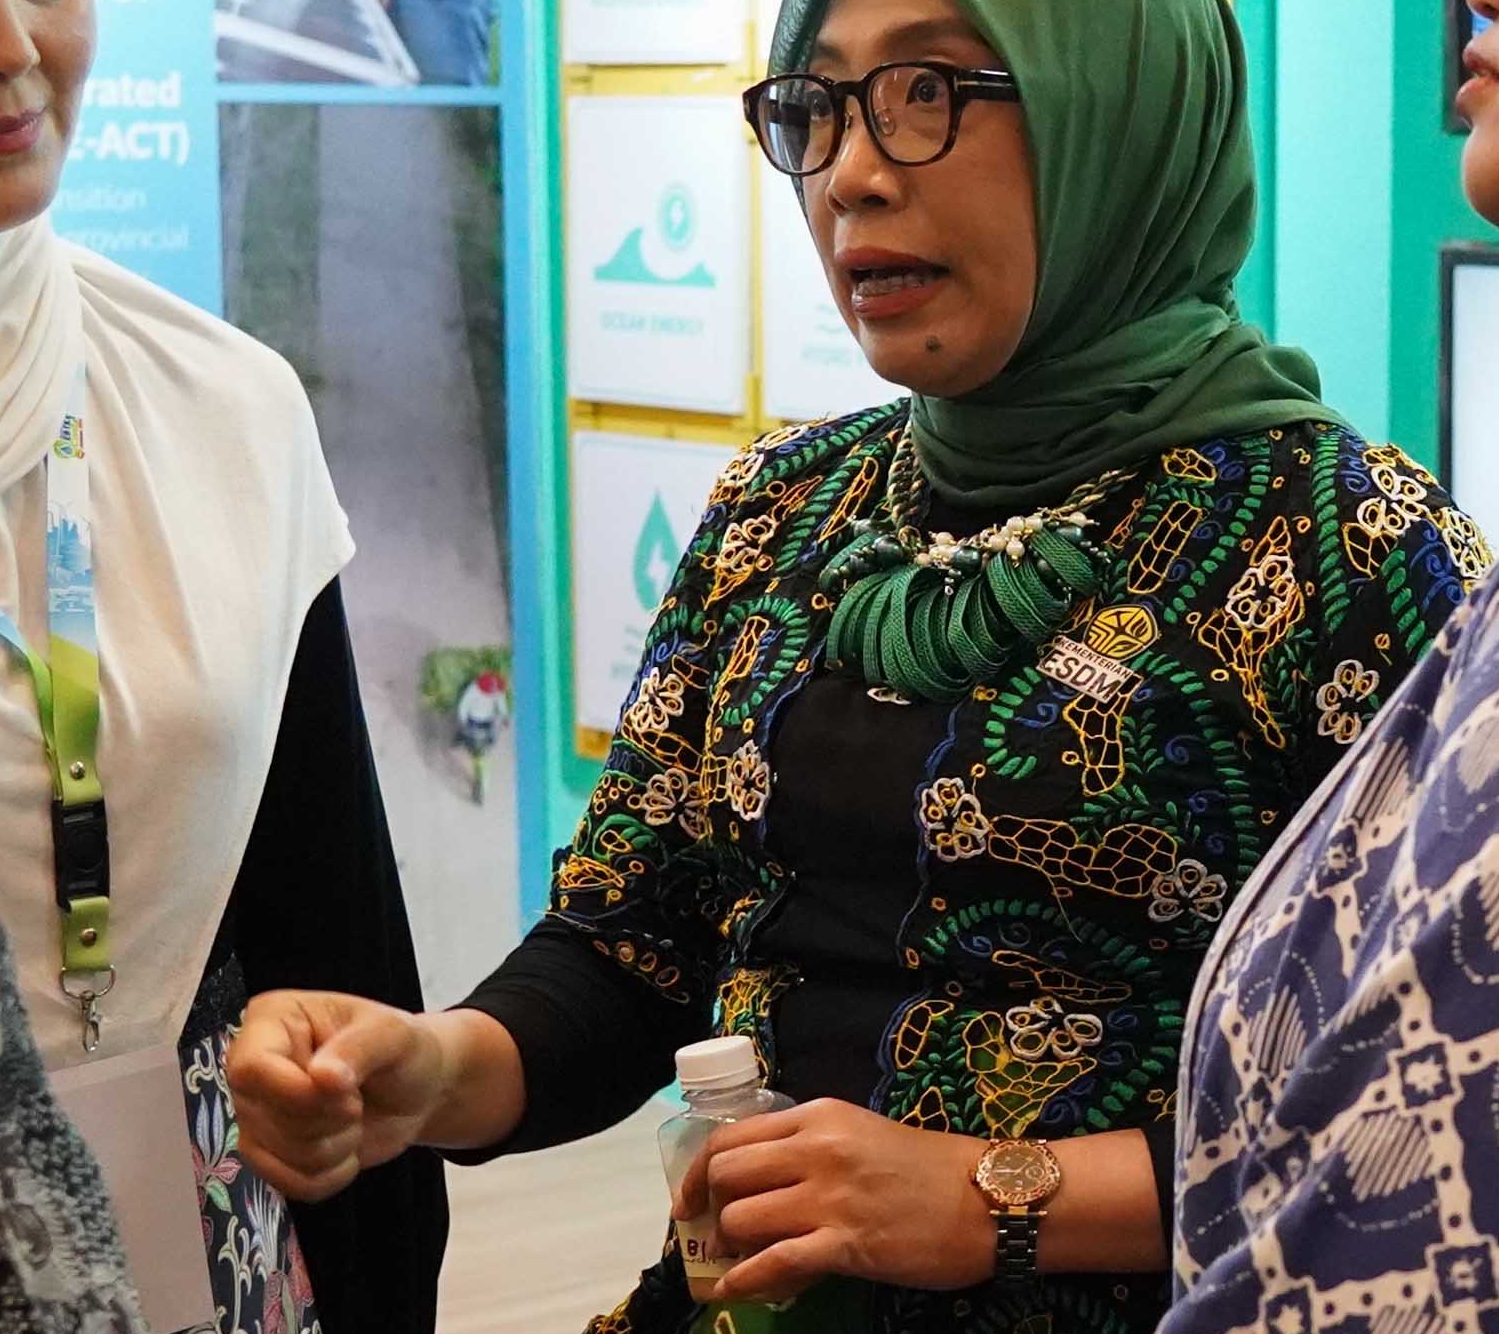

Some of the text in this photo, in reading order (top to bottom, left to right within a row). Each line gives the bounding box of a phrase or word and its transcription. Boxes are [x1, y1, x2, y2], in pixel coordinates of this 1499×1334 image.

[82, 71, 181, 107] rated
[57, 182, 148, 213] nsition
[1041, 648, 1122, 700] ESDM
[1059, 638, 1132, 679] KEMENTERIAN
